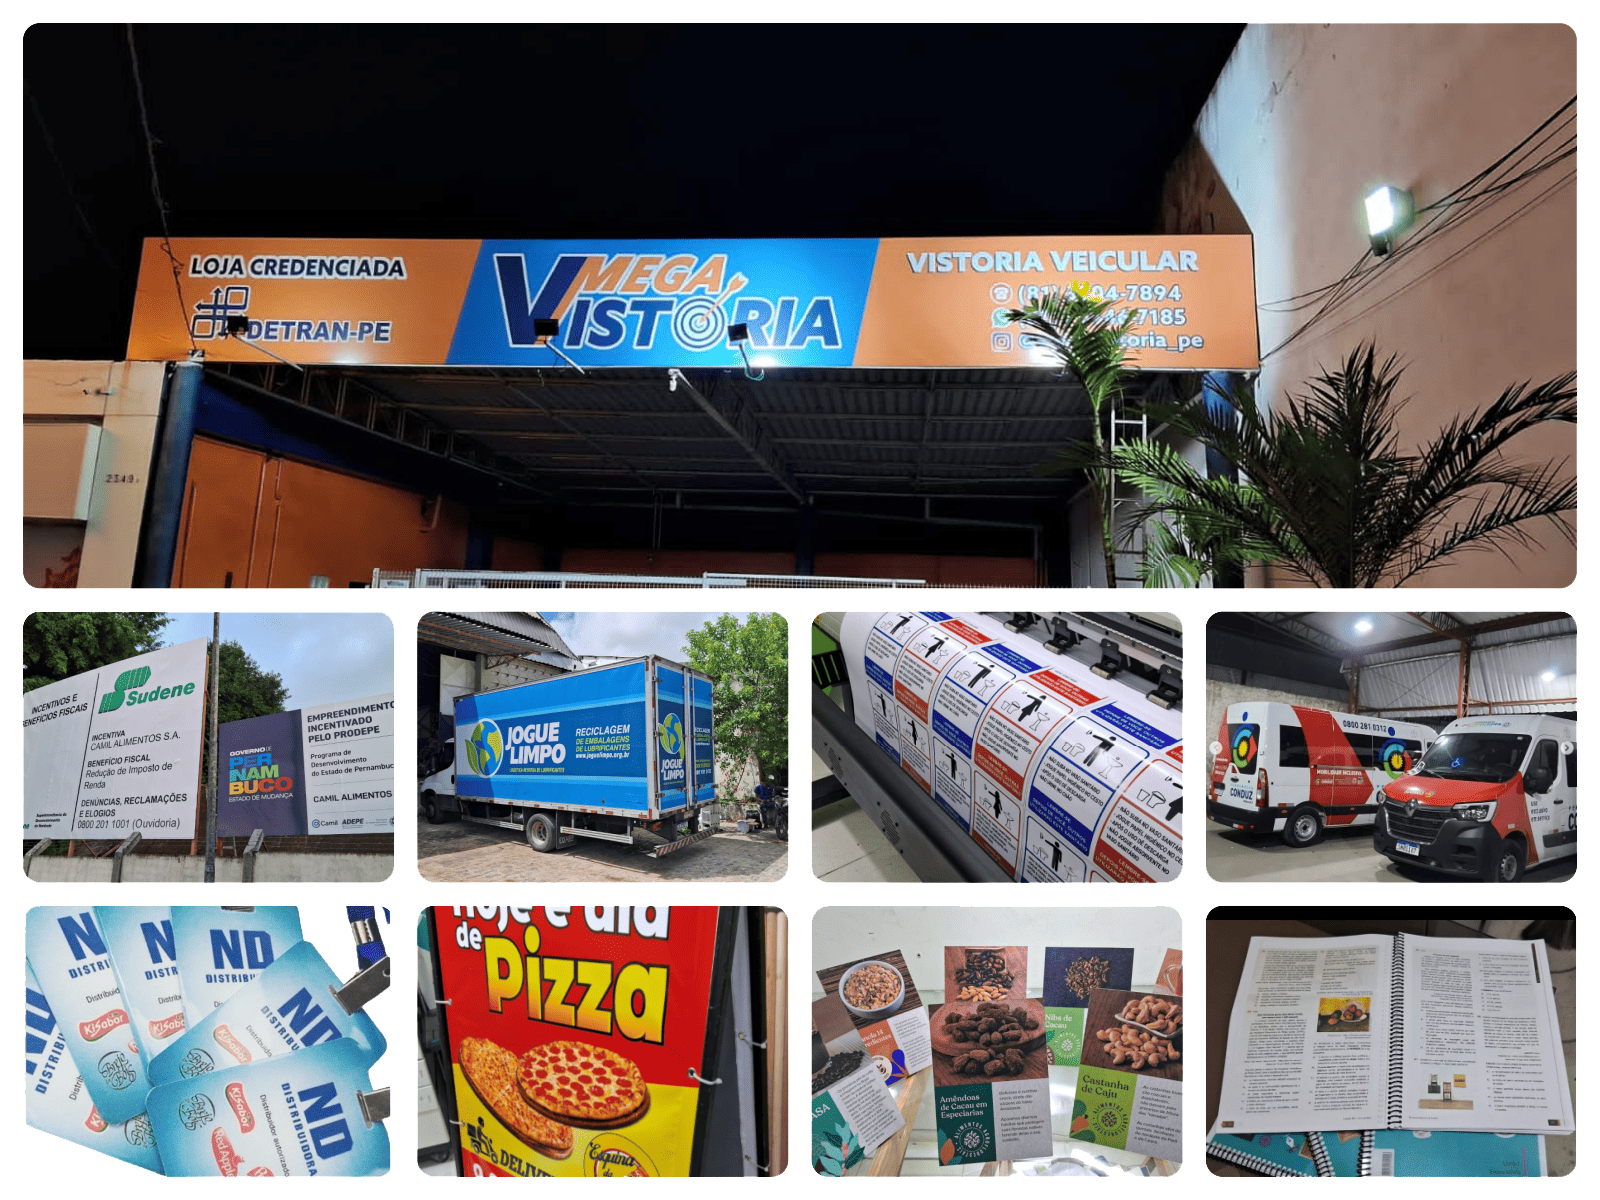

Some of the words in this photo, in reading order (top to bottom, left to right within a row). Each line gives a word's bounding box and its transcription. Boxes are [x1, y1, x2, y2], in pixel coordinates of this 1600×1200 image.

[189, 256, 244, 278] LOJA
[250, 256, 406, 280] CREDENCIADA
[906, 251, 1044, 273] VISTORIA
[1049, 250, 1200, 272] VEICULAR
[580, 253, 729, 295] MEGA
[248, 320, 391, 342] DETRAN-PE
[126, 682, 196, 707] Sudene
[31, 696, 72, 715] INCENTIVOS
[72, 694, 78, 702] E
[58, 702, 88, 718] FISCAIS
[308, 716, 372, 733] INCENTIVADO
[576, 724, 630, 737] RECICLAGEM
[1343, 720, 1359, 729] 0800
[1360, 722, 1371, 731] 281
[1372, 722, 1387, 732] 0312
[90, 740, 113, 752] CAMIL
[113, 734, 162, 748] ALIMENTOS
[164, 731, 181, 741] S.A.
[92, 730, 126, 742] INCENTIVA
[308, 732, 332, 744] PELO
[333, 725, 380, 740] PRODEPE
[505, 721, 560, 751] JOGUE
[585, 735, 630, 745] EMBALAGENS
[229, 746, 266, 757] GOVERNO
[310, 750, 342, 760] Programa
[343, 748, 352, 756] de
[509, 744, 566, 764] LIMPO
[575, 751, 630, 760] www.joguelimpo.org.br
[584, 744, 630, 752] LUBRIFICANTES
[88, 756, 123, 768] BENEFÍCIO
[124, 754, 150, 764] FISCAL
[229, 752, 272, 770] PER
[310, 756, 367, 768] Desenvolvimento
[661, 759, 682, 773] JOGUE
[86, 768, 116, 779] Redução
[116, 767, 127, 776] de
[128, 764, 160, 776] Imposto
[162, 762, 173, 772] de
[229, 764, 279, 782] NAM
[311, 769, 320, 777] do
[320, 767, 343, 776] Estado
[344, 766, 353, 774] de
[663, 769, 684, 781] LIMPO
[1056, 761, 1066, 770] SUBA
[1080, 778, 1101, 795] SANITÁRIO
[84, 780, 106, 790] Renda
[229, 776, 294, 796] BUCO
[1045, 763, 1056, 772] JOGUE
[1055, 769, 1067, 780] PAPEL
[1090, 794, 1104, 807] CESTO
[80, 796, 122, 808] DENÚNCIAS,
[124, 792, 188, 806] RECLAMAÇÕES
[228, 794, 251, 802] ESTADO
[260, 792, 294, 800] MUDANÇA
[313, 793, 340, 803] CAMIL
[342, 790, 392, 802] ALIMENTOS
[1067, 786, 1086, 804] DESCARGA
[1230, 788, 1253, 800] CONDUZ
[79, 810, 84, 818] E
[84, 809, 116, 818] ELOGIOS
[342, 818, 364, 826] ADEPE
[1120, 806, 1130, 816] NÃO
[1130, 812, 1142, 824] SUBA
[1142, 821, 1150, 830] NO
[1149, 826, 1162, 838] VASO
[77, 820, 94, 829] 0800
[95, 820, 109, 829] 201
[112, 820, 130, 829] 1001
[132, 817, 180, 831] (Ouvidoria)
[1112, 820, 1124, 831] APÓS
[1128, 830, 1138, 841] USO
[1137, 837, 1145, 846] DÊ
[1144, 843, 1169, 864] DESCARGA
[1116, 814, 1130, 826] JOGUE
[1130, 823, 1144, 836] PAPEL
[1144, 833, 1168, 853] HIGIÊNICO
[1167, 850, 1176, 858] NO
[1106, 833, 1118, 844] VASO
[1117, 842, 1140, 862] SANITÁRIO
[1108, 826, 1119, 836] NÃO
[1118, 834, 1134, 848] JOGUE
[1132, 844, 1162, 870] ABSORVENTE
[1161, 866, 1170, 875] NO
[455, 920, 483, 952] de
[210, 929, 274, 970] ND
[483, 924, 670, 1046] Pizza
[1081, 1084, 1094, 1093] de
[1094, 1086, 1118, 1099] Caju
[1082, 1074, 1130, 1092] Castanha
[940, 1094, 980, 1104] Amêndoas
[951, 1102, 975, 1110] Cacau
[297, 1082, 354, 1160] ND
[940, 1110, 984, 1120] Especiarias
[260, 1094, 278, 1138] Distribuidor
[272, 1137, 290, 1178] autorizado
[281, 1082, 318, 1177] DISTRIBUIDORA
